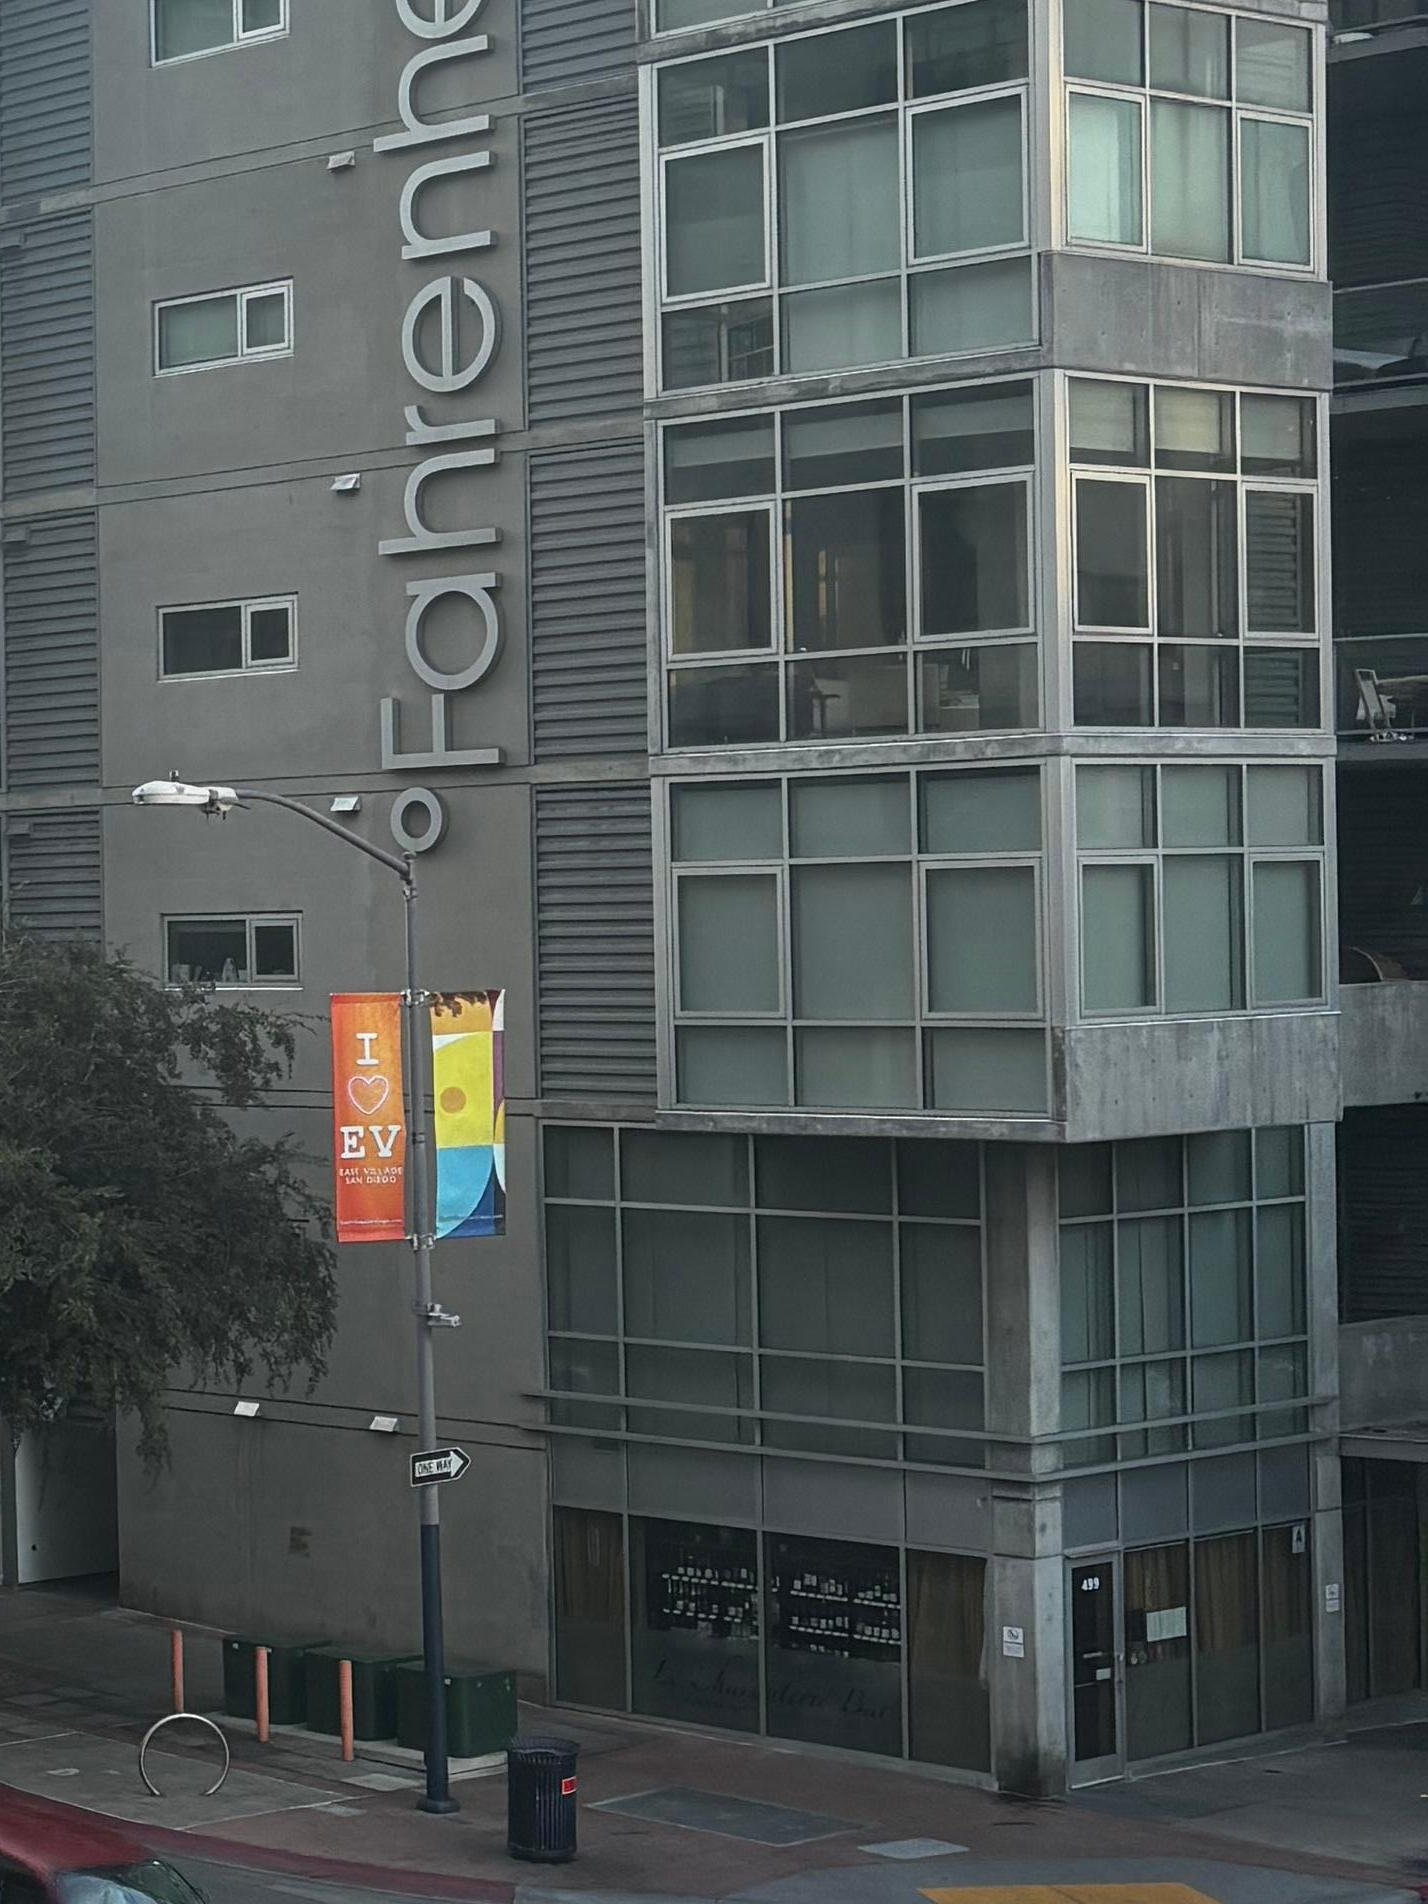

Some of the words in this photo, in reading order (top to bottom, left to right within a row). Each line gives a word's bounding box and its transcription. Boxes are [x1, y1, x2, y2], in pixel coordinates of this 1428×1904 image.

[355, 1032, 379, 1065] I
[339, 1124, 401, 1158] EV
[339, 1167, 358, 1175] EAST
[363, 1166, 402, 1175] VILLAGE
[345, 1176, 362, 1184] SAN
[366, 1175, 396, 1183] DIEGO
[417, 1462, 433, 1473] ONE
[436, 1458, 452, 1471] WAY
